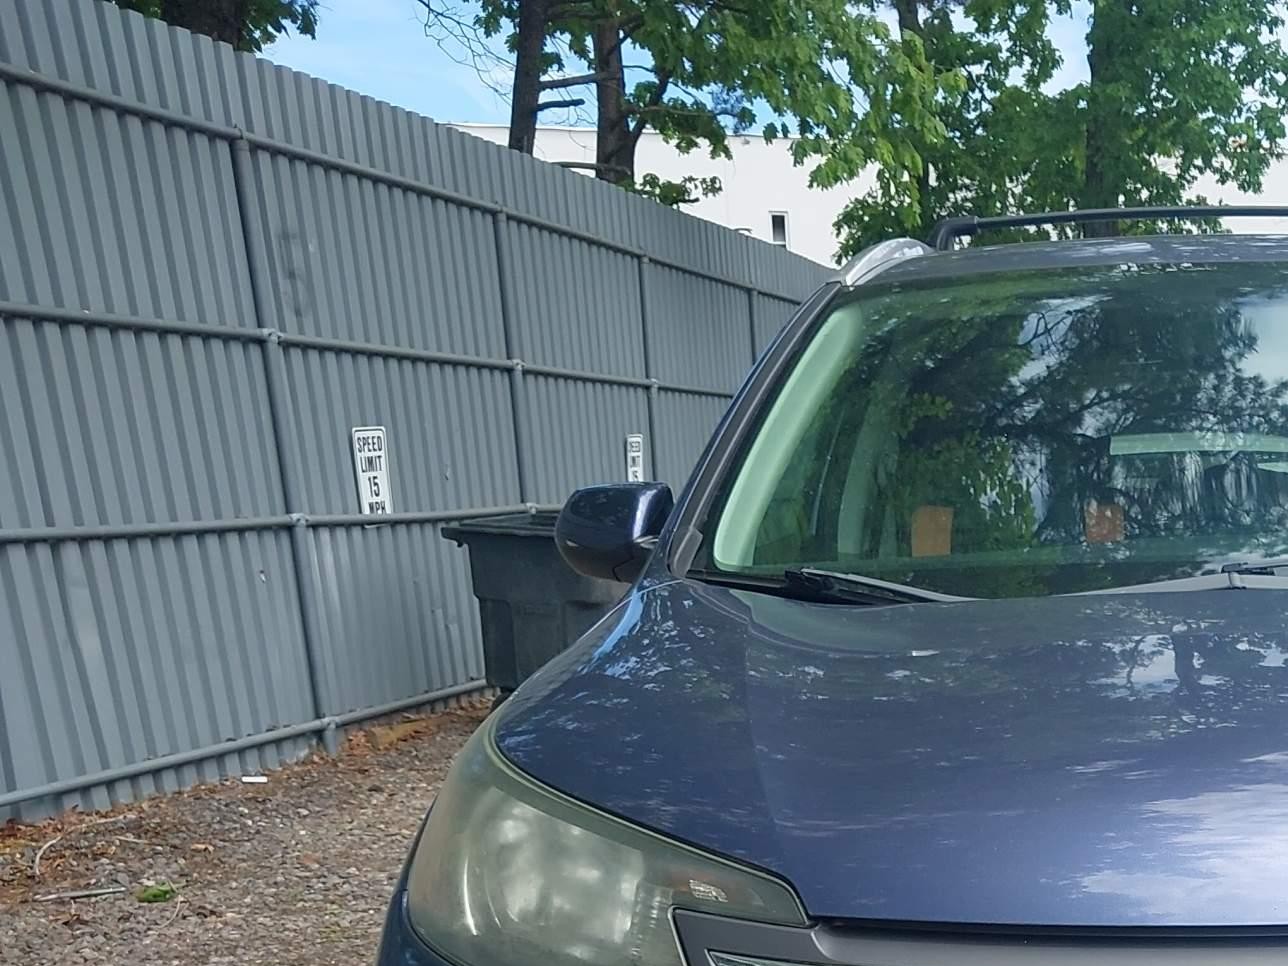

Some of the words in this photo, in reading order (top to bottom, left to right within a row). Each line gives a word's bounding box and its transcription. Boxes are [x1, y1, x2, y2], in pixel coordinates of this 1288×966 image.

[356, 436, 383, 453] SPEED
[360, 455, 383, 473] LIMIT
[368, 475, 381, 498] 15
